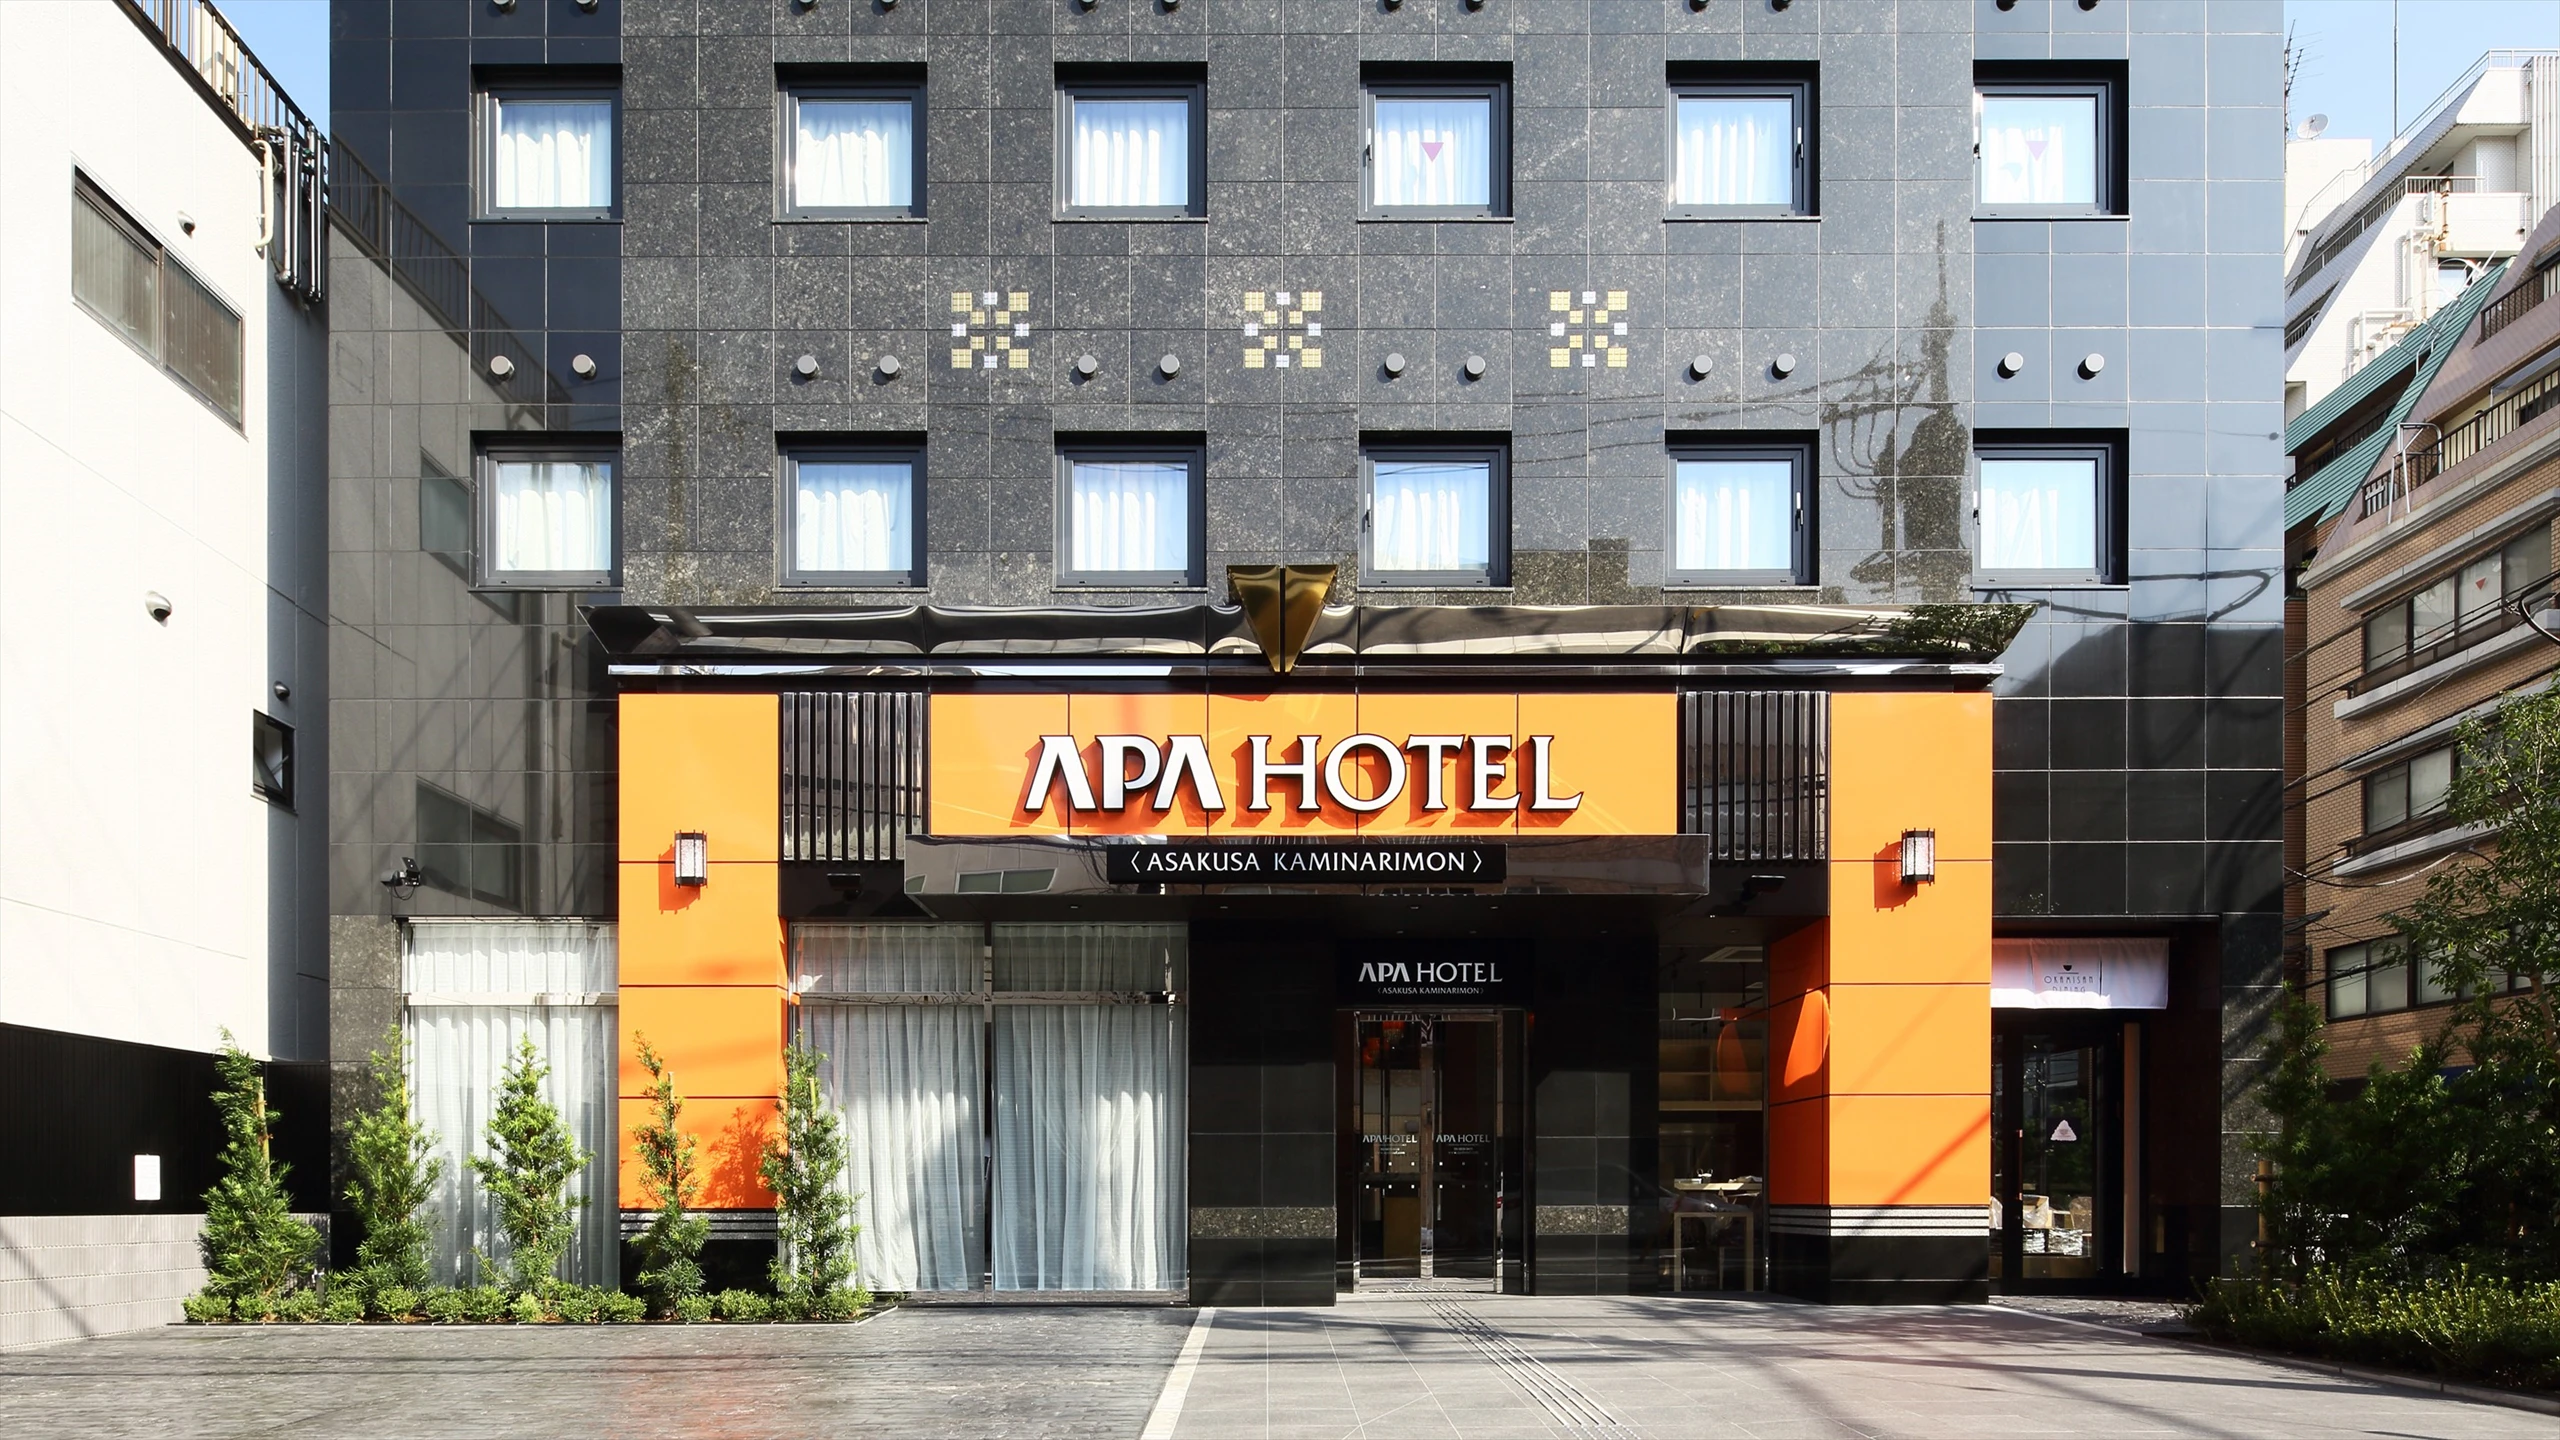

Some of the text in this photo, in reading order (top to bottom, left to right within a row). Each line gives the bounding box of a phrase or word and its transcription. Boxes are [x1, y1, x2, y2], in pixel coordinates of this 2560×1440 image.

[1024, 734, 1584, 812] APA HOTEL
[1358, 962, 1503, 983] APA HOTEL
[1362, 1134, 1418, 1143] APA HOTEL
[1435, 1134, 1490, 1143] APA HOTEL
